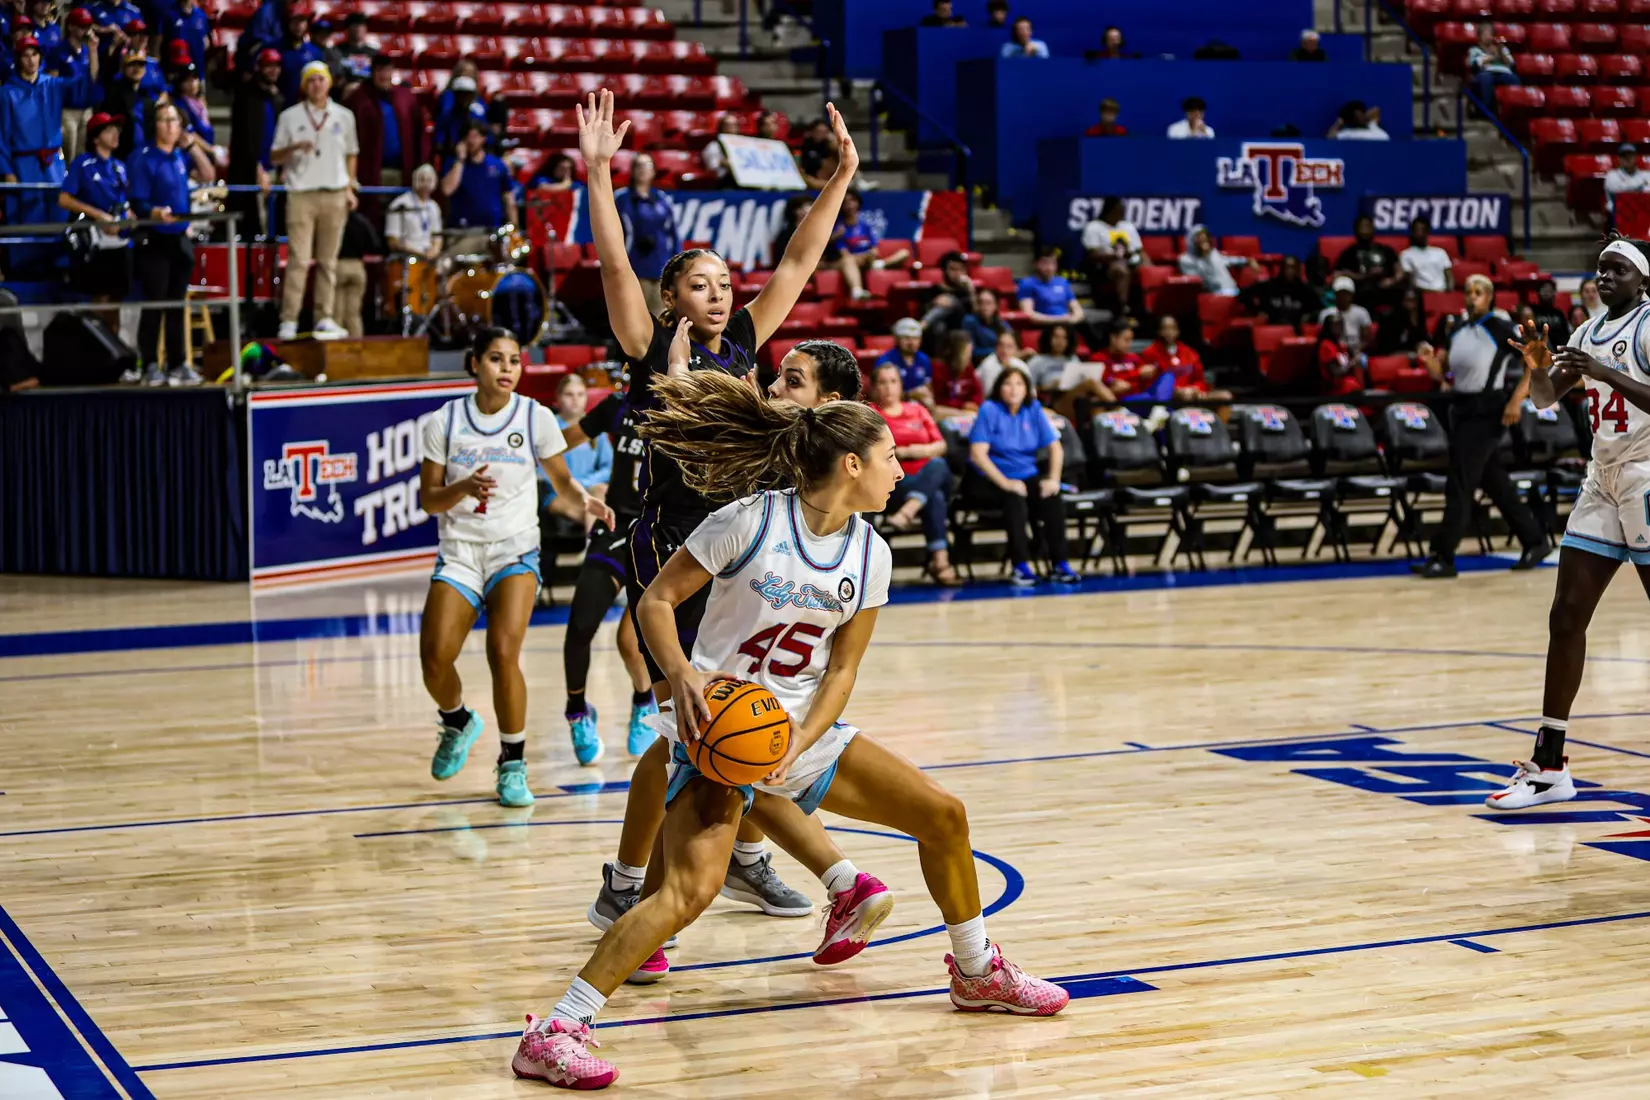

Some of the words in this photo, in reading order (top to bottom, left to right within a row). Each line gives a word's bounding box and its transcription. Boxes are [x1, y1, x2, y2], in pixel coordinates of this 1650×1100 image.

[1067, 198, 1201, 230] STDENT
[1373, 198, 1500, 230] SECTION
[1585, 387, 1629, 433] 34
[617, 435, 646, 457] LS
[749, 571, 796, 610] Lady
[737, 621, 827, 678] 45
